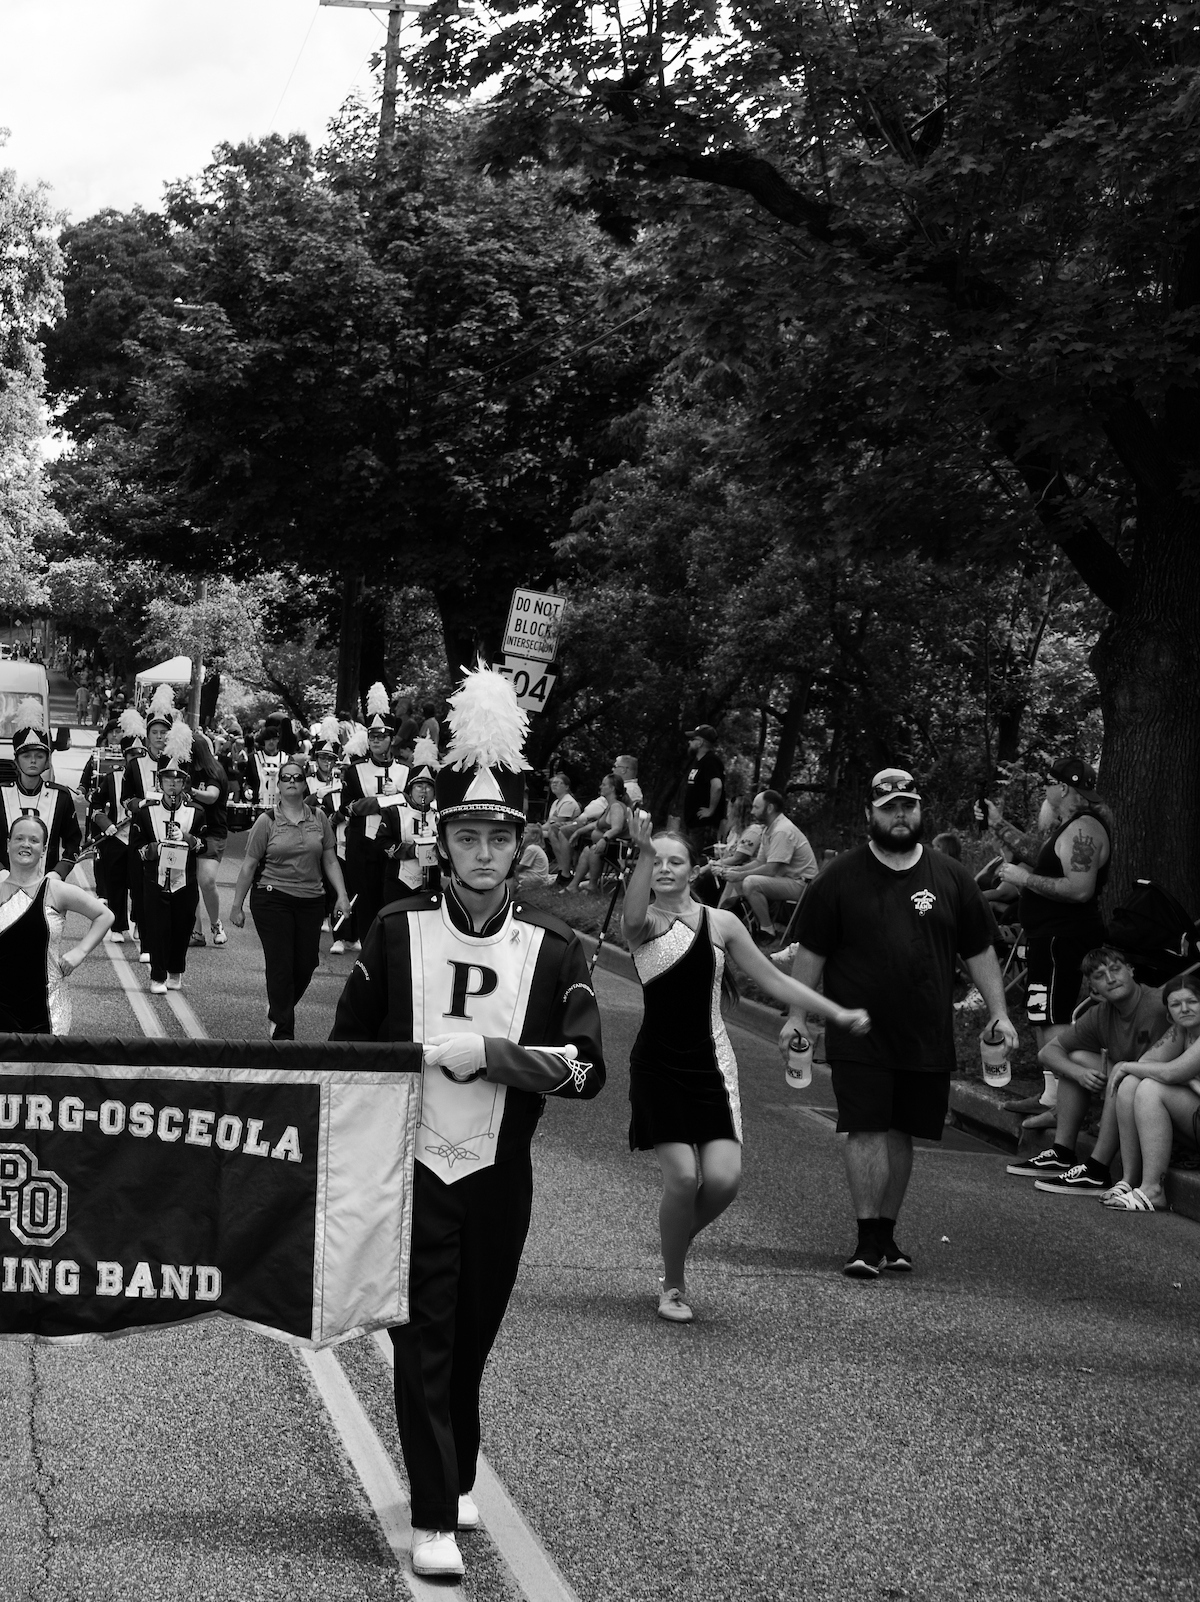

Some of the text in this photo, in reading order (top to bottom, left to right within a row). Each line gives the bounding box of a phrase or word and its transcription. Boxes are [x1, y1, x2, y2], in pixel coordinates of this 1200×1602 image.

[516, 596, 560, 617] DO NOT
[515, 618, 552, 637] BLOCK
[442, 959, 500, 1022] P
[96, 1261, 222, 1301] BAND
